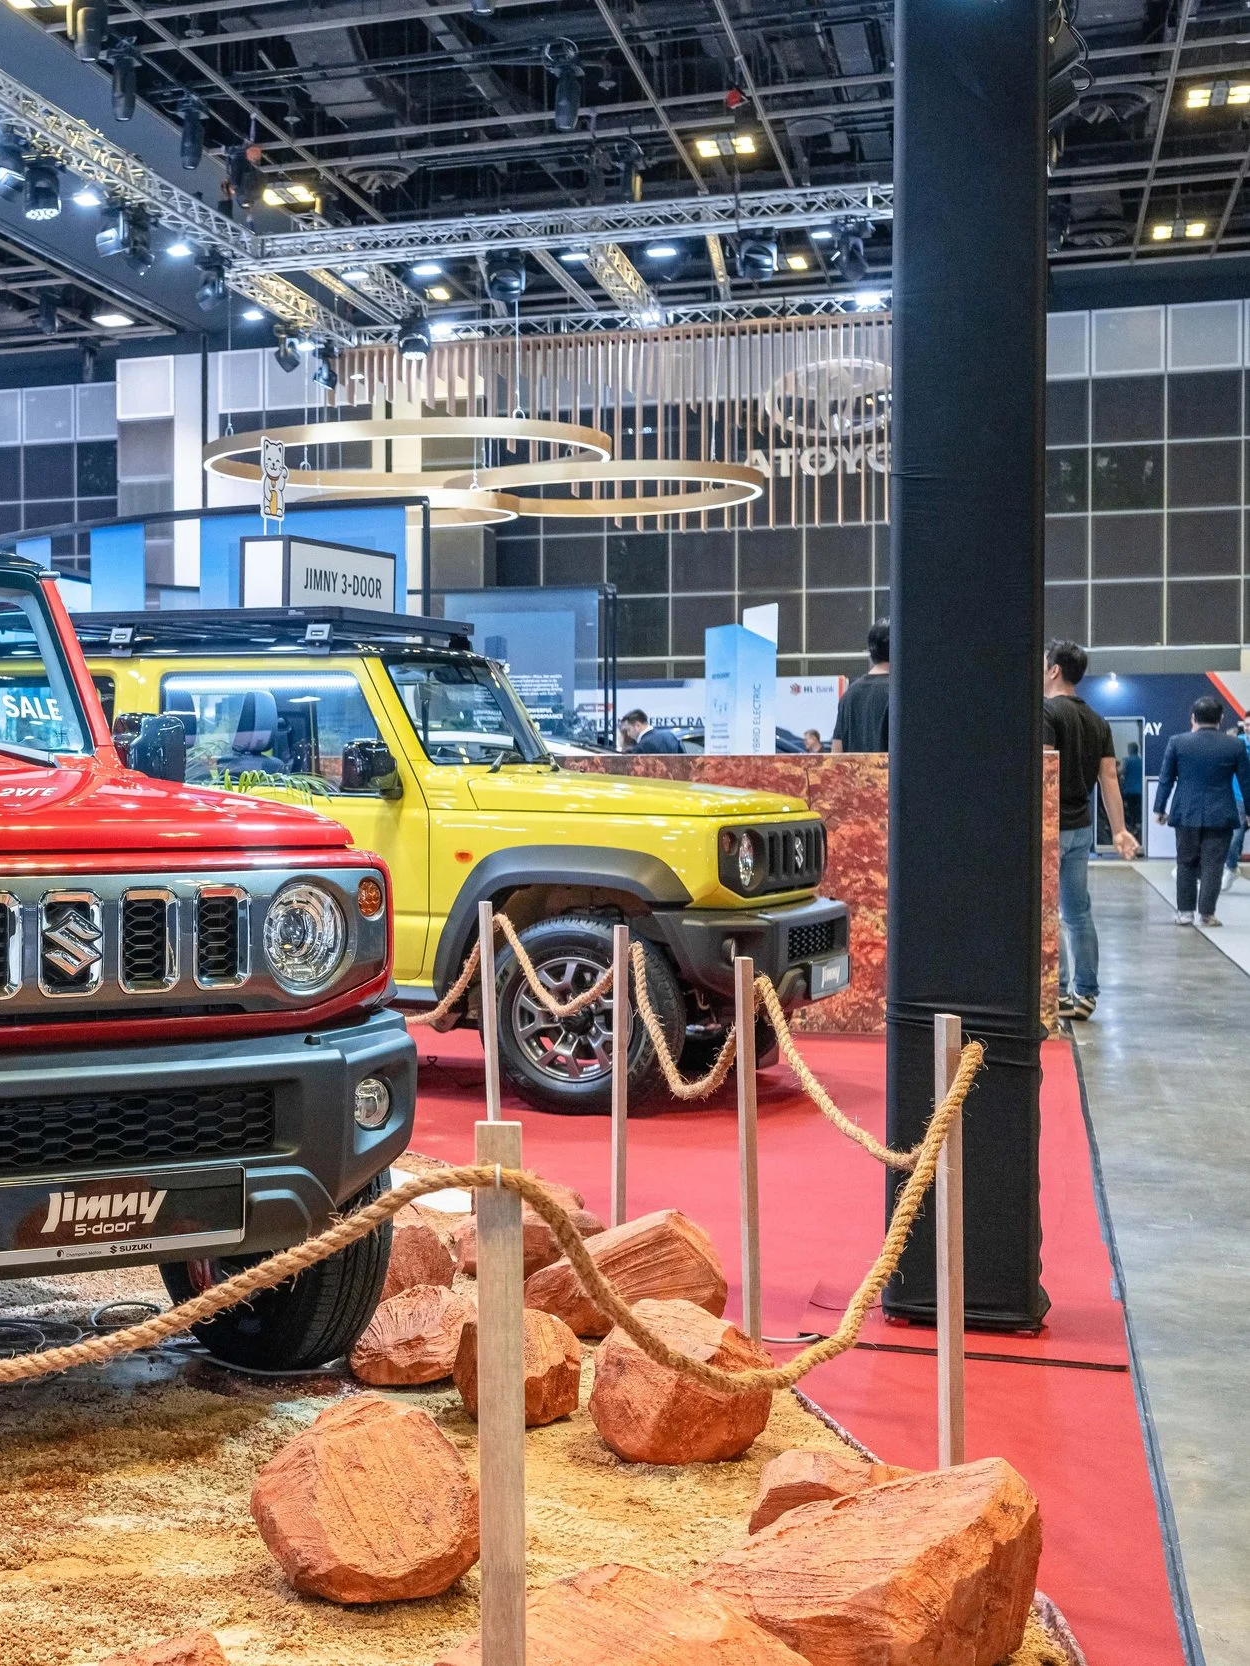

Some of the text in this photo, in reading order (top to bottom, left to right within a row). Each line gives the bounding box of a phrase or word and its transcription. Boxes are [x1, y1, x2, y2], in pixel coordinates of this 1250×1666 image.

[304, 567, 382, 600] JIMNY 3-DOOR
[2, 695, 64, 722] SALE
[752, 683, 762, 726] ELECTRIC
[650, 717, 683, 727] EREST
[1143, 722, 1162, 736] AY
[40, 1190, 168, 1233] Jimny
[74, 1221, 137, 1237] 5-door
[119, 1243, 152, 1253] SUZUKI
